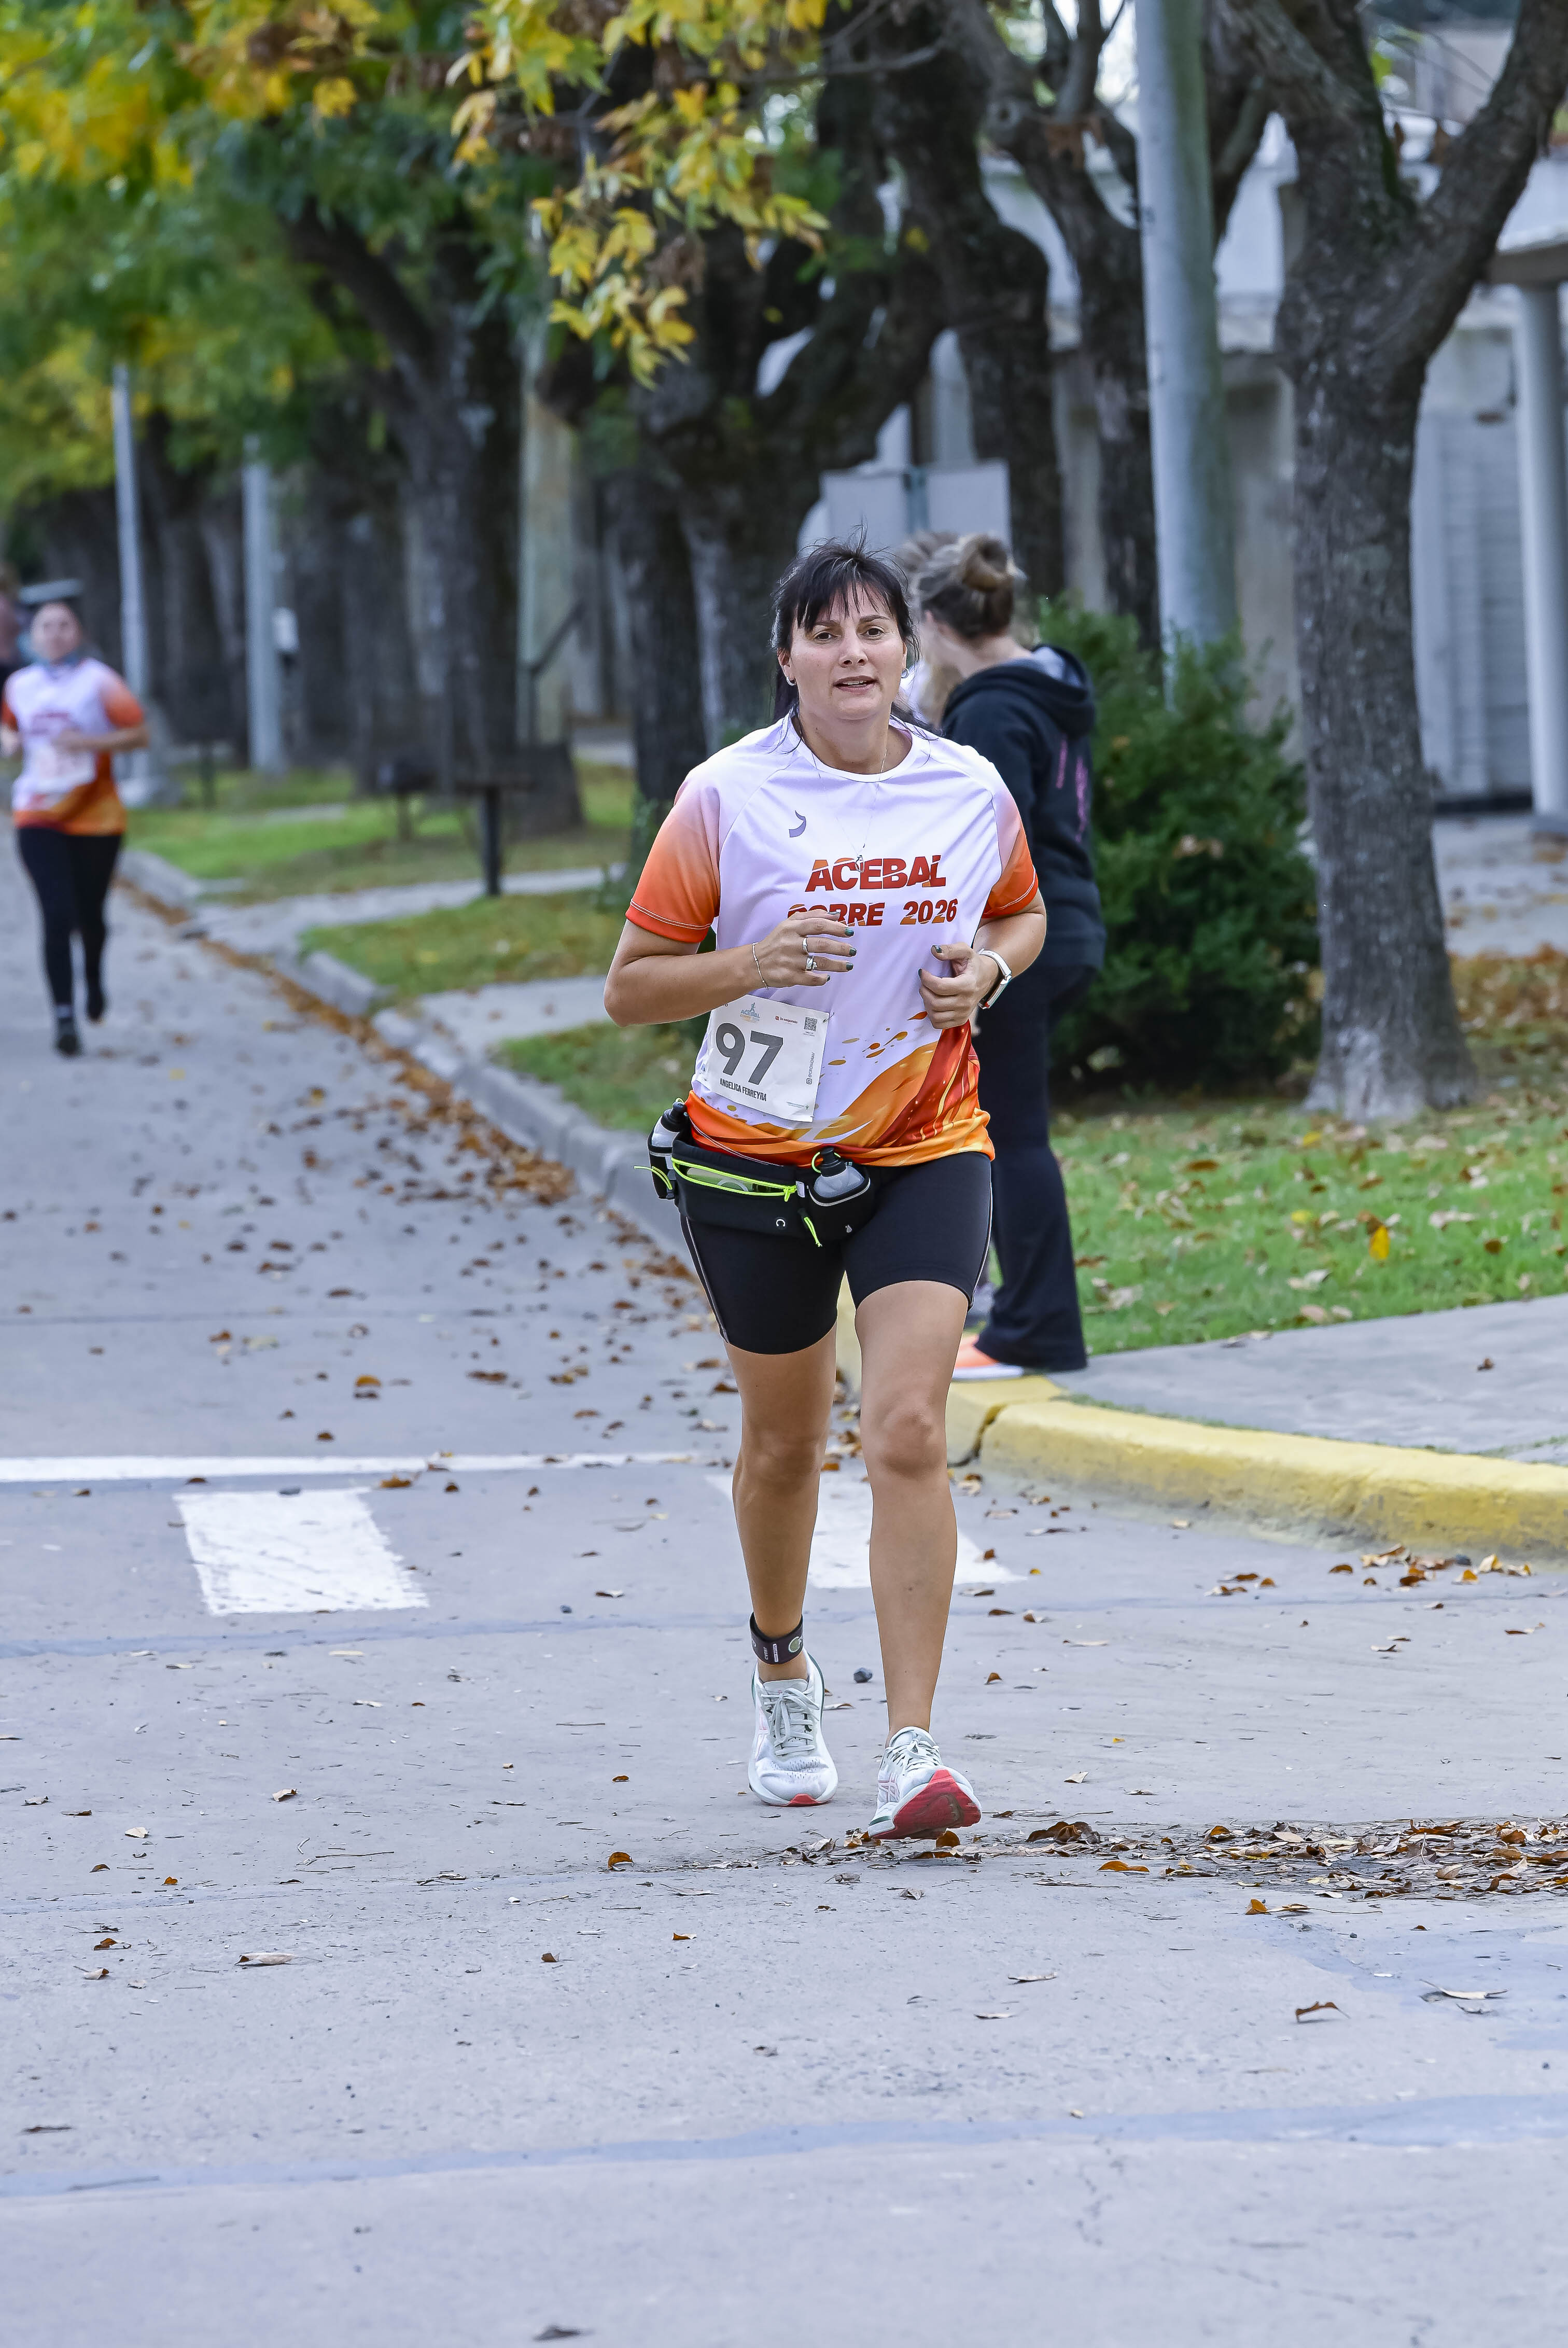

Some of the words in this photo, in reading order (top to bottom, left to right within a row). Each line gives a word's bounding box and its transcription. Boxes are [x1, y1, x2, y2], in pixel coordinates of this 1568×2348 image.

[805, 855, 946, 892] ACEBAL
[900, 899, 958, 925] 2026
[716, 1023, 783, 1085] 97
[720, 1078, 741, 1093] ANGELICA
[742, 1086, 767, 1102] FERREYRA
